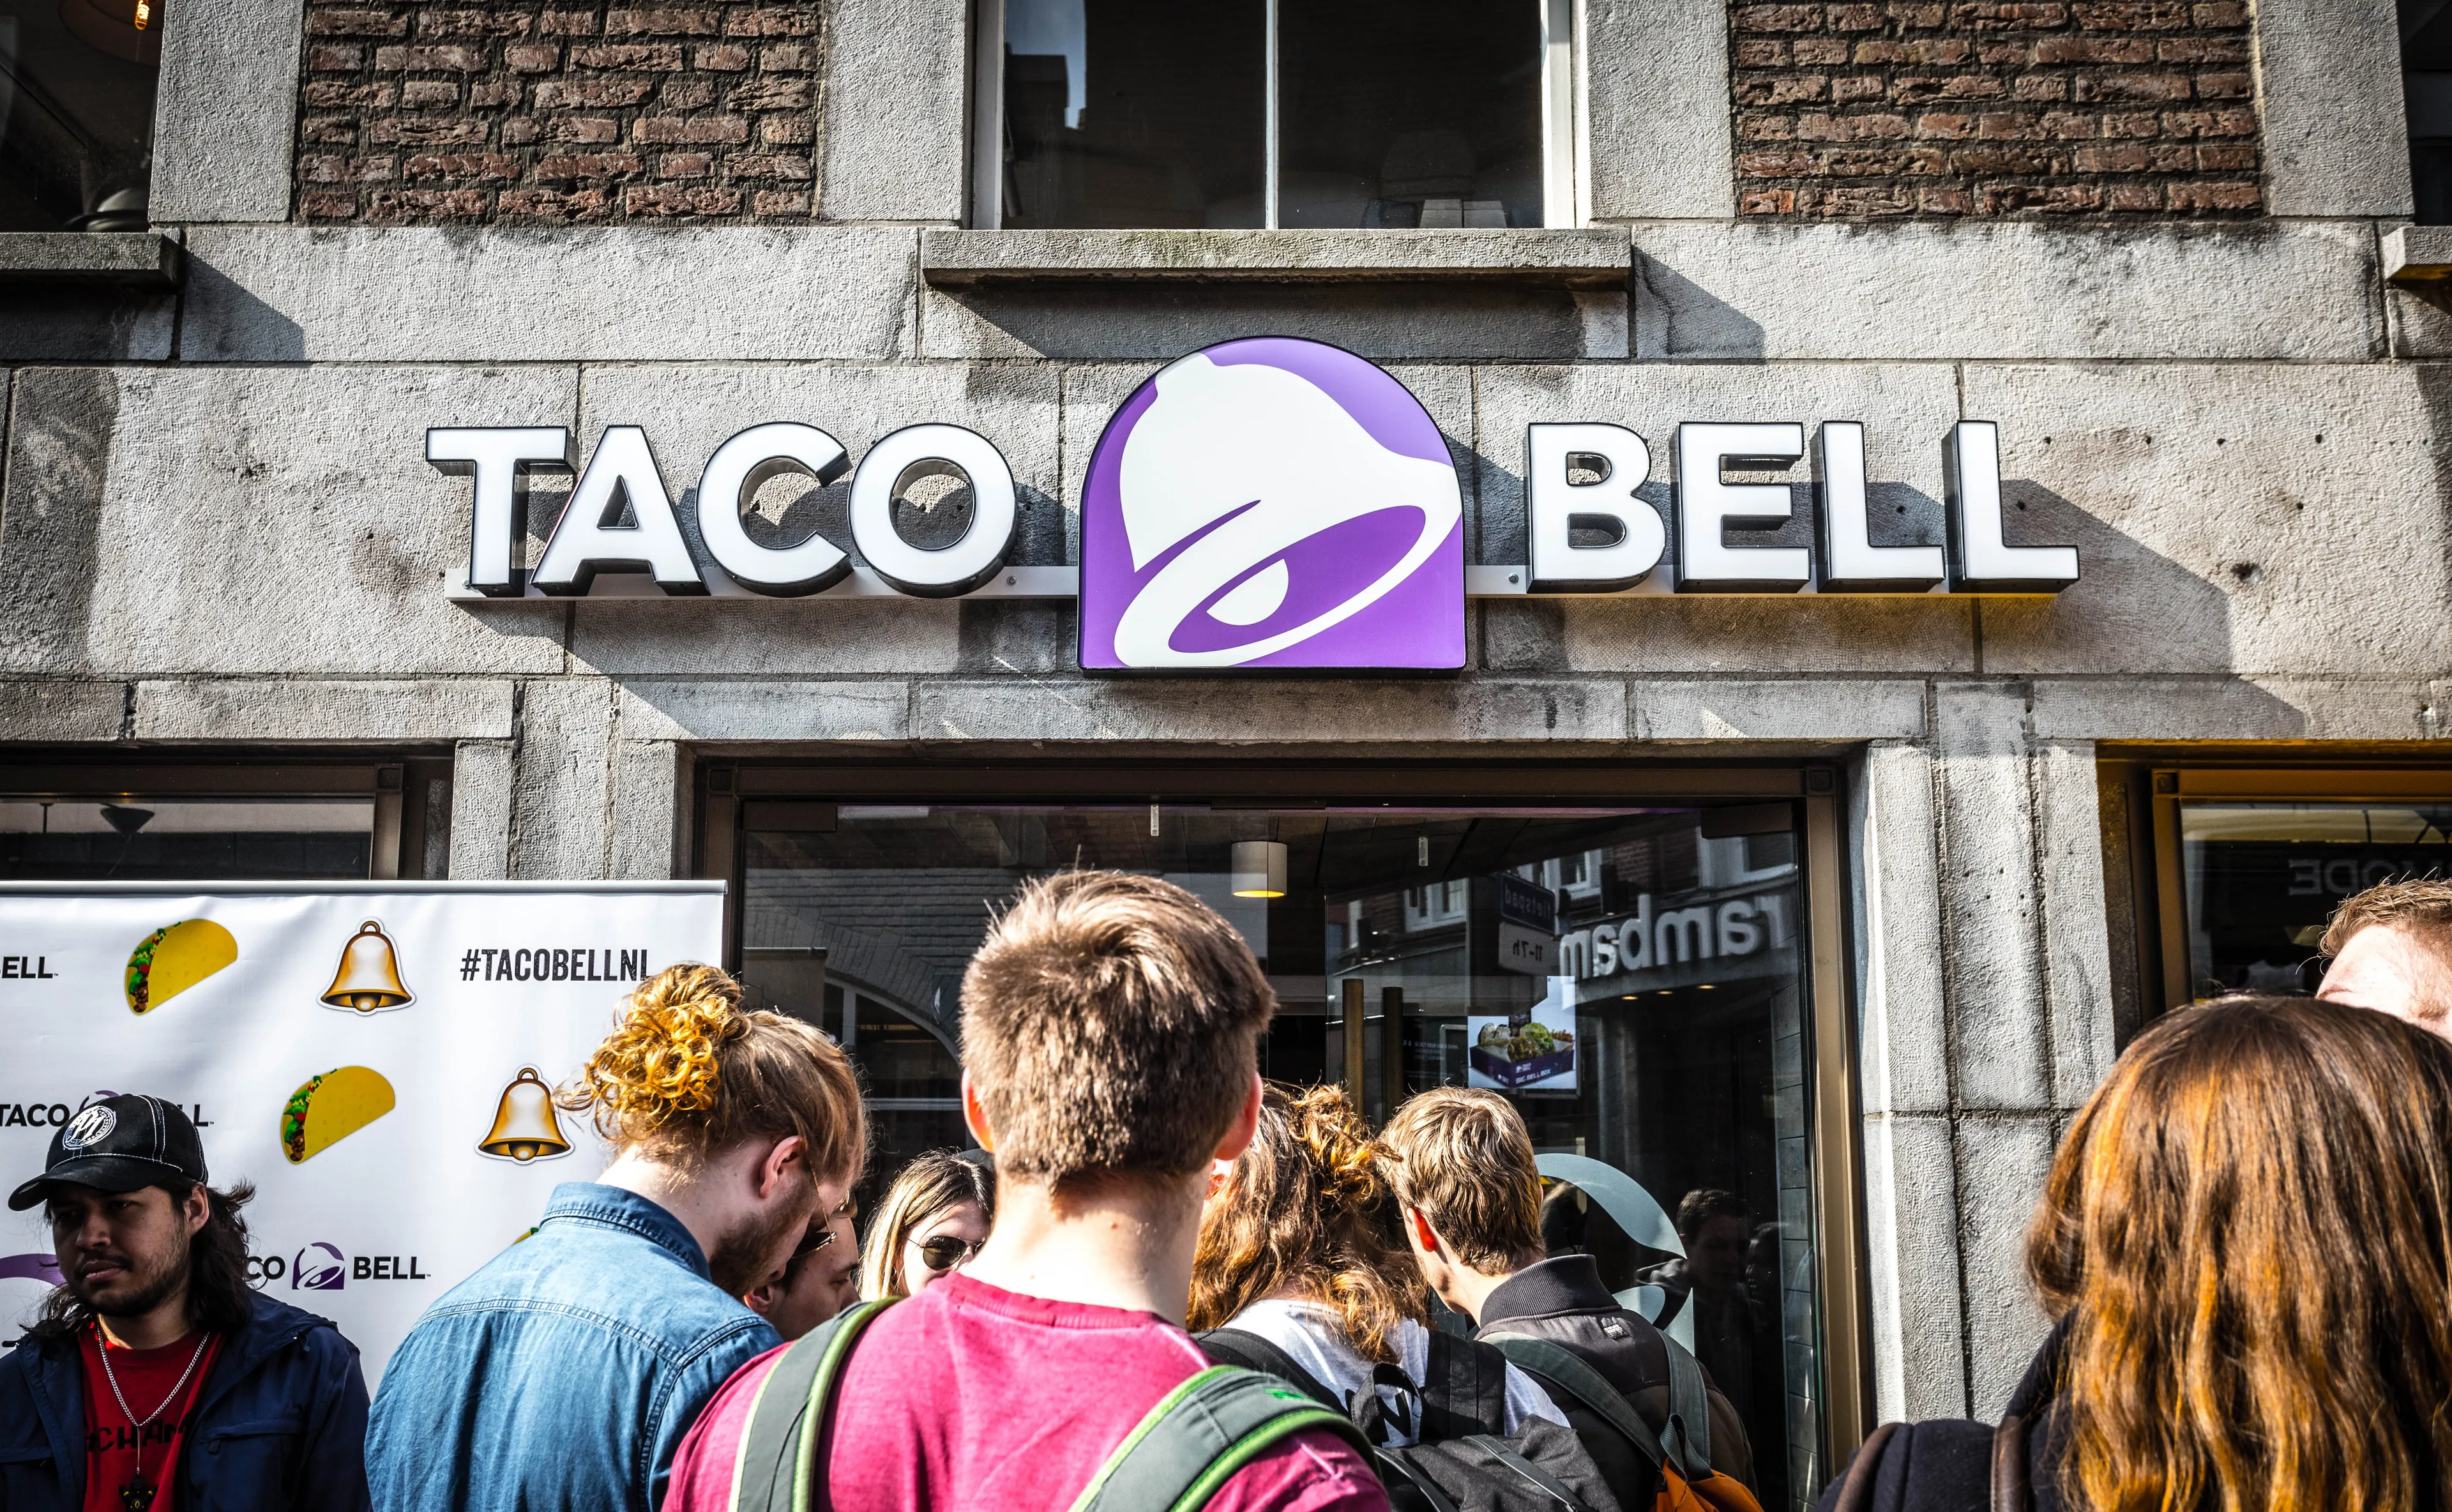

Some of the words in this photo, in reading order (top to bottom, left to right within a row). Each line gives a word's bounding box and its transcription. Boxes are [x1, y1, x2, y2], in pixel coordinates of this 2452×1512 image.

[425, 421, 1020, 596] TACO
[1526, 420, 2080, 594] BELL
[460, 948, 651, 981] #TACOBELLNL
[0, 1103, 70, 1127] TACO
[246, 1255, 286, 1280] CO
